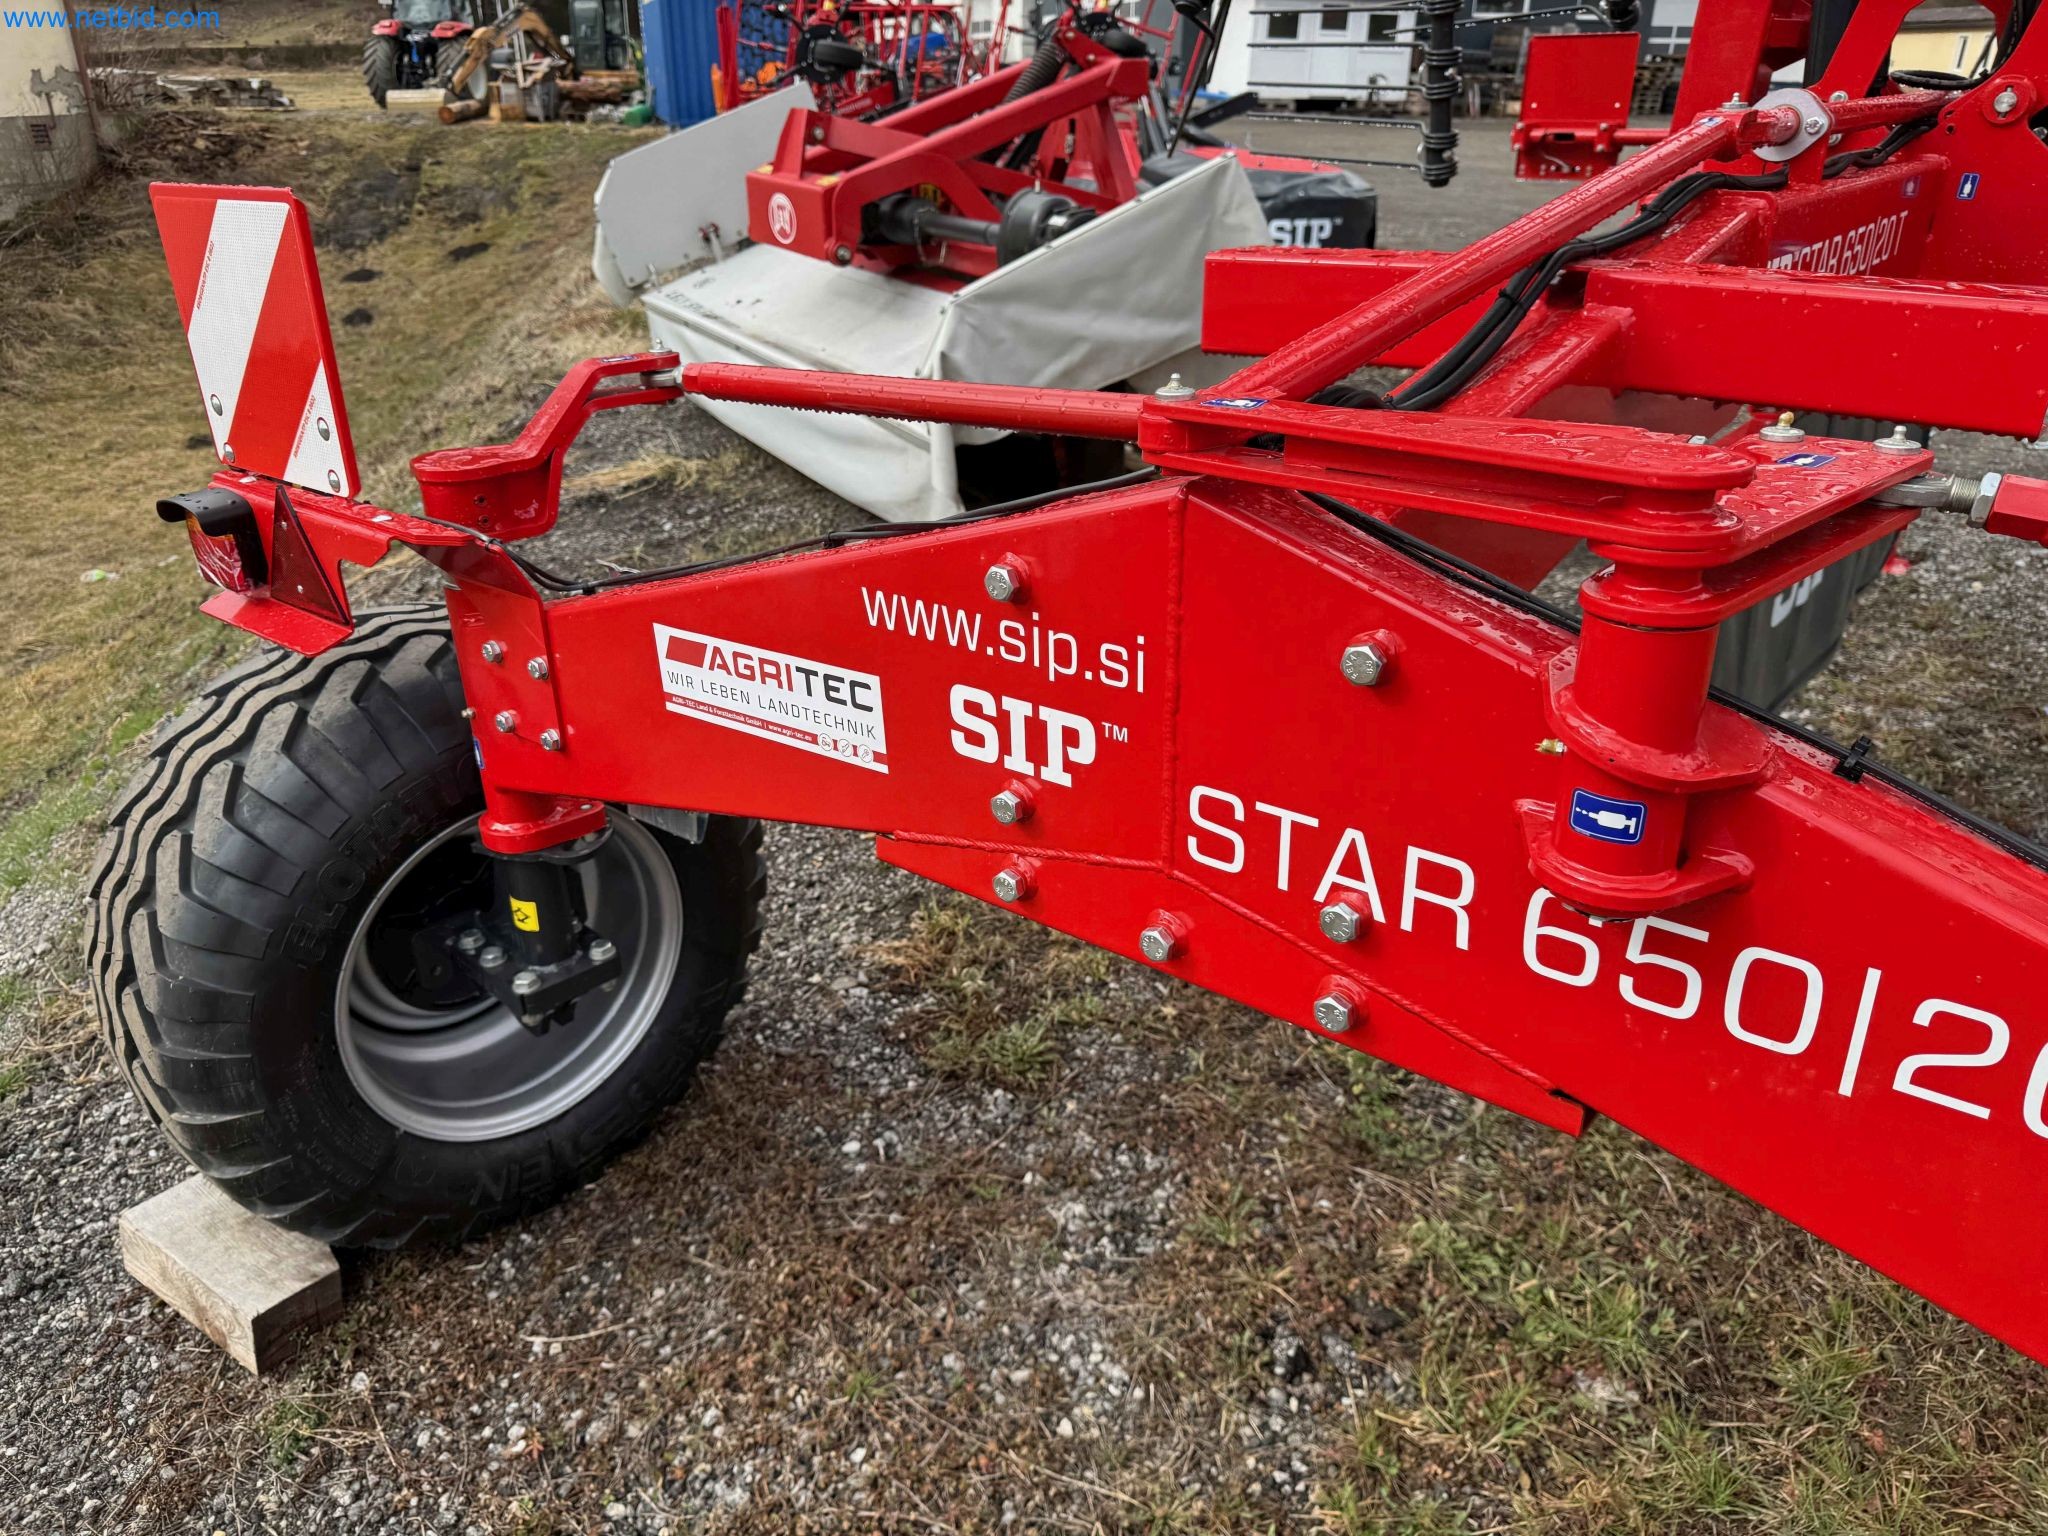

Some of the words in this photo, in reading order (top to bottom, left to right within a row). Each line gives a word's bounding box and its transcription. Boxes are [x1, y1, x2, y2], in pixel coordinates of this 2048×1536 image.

[1268, 217, 1333, 248] SIP
[1894, 210, 1909, 256] T
[861, 586, 1145, 693] www.sip.si
[667, 670, 694, 689] WIR
[701, 679, 750, 704] LEBEN
[758, 694, 876, 740] LANDTECHNIK
[709, 645, 873, 713] AGRITEC
[949, 683, 1096, 788] SIP
[1187, 785, 1475, 951] STAR
[1522, 886, 2048, 1140] 650|2
